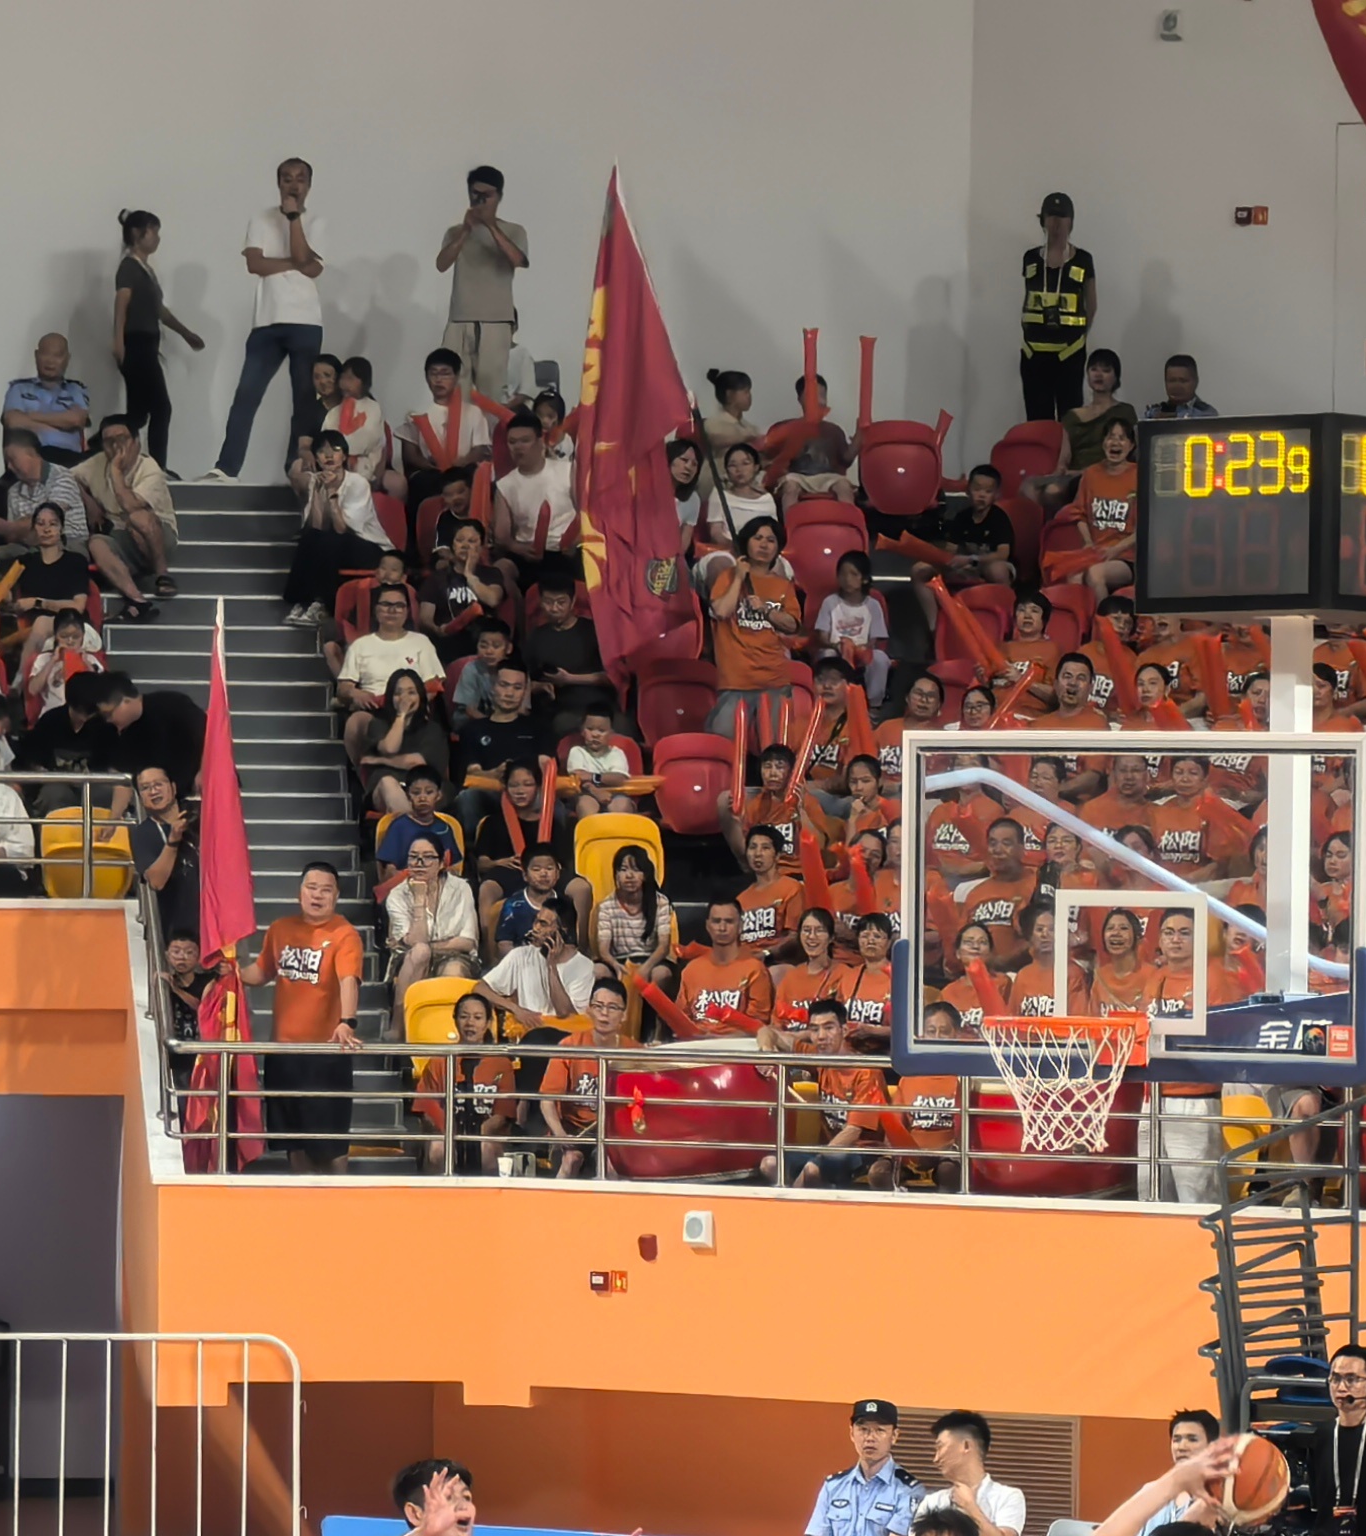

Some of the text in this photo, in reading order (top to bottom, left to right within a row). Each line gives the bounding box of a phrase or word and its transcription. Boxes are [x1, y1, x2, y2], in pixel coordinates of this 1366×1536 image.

[1161, 829, 1203, 852] 松阳
[974, 901, 1014, 922] 松阳
[278, 946, 324, 971] 松阳
[846, 999, 884, 1024] 松阳
